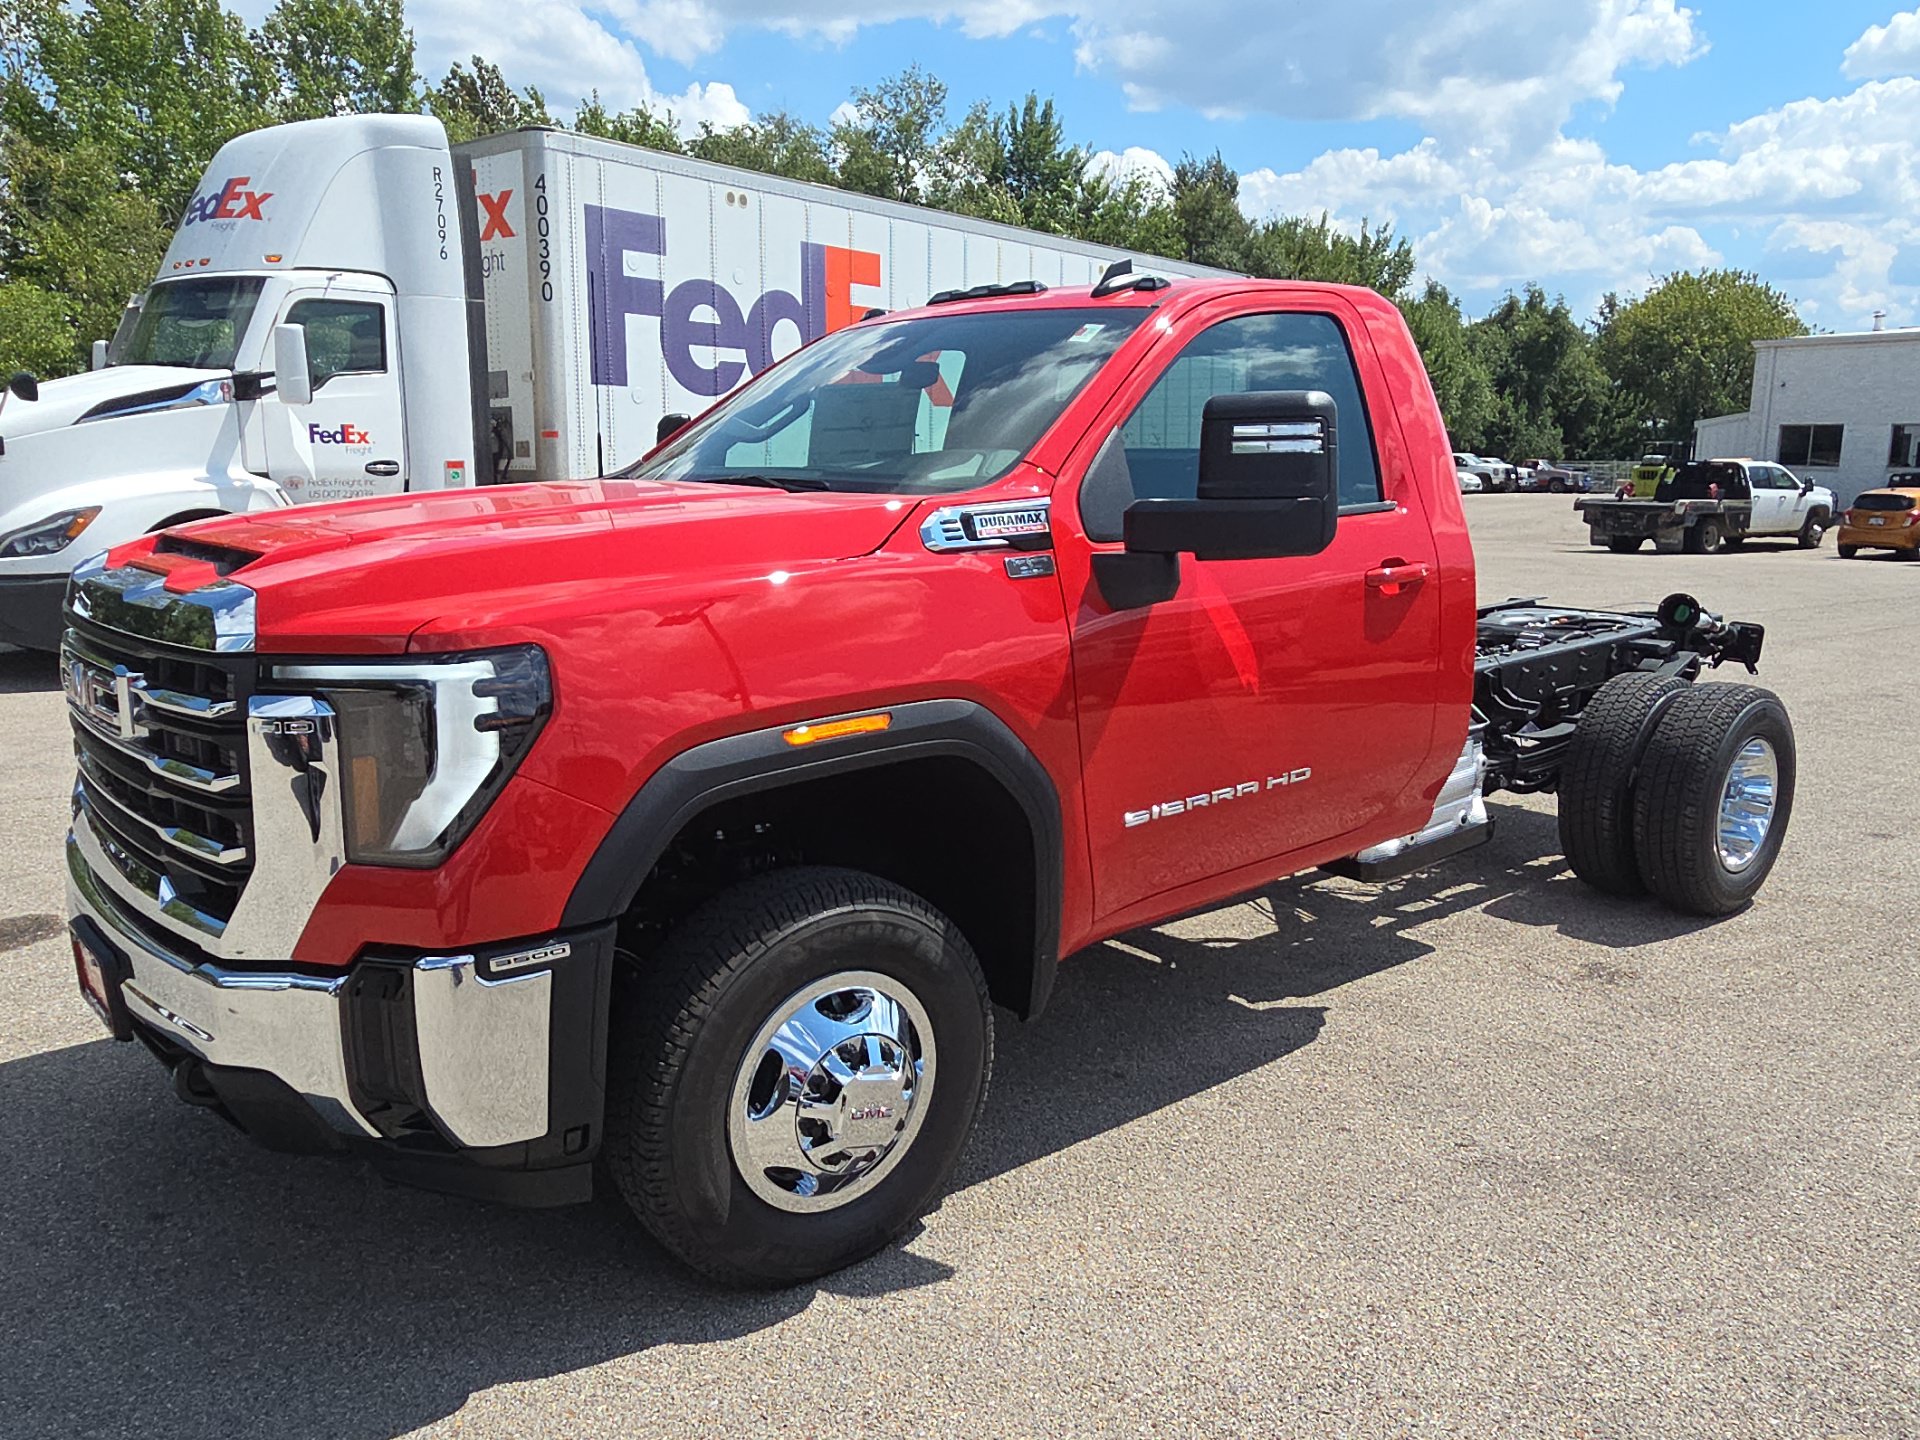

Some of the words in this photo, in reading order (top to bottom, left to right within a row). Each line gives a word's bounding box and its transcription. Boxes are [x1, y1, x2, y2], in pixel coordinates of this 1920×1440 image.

[185, 176, 274, 227] edEx
[433, 167, 448, 260] R27096
[534, 173, 553, 302] 400390
[308, 423, 370, 444] FedEx
[979, 512, 1043, 528] DURAMAX
[1124, 781, 1259, 828] SIERRA
[1266, 767, 1312, 790] HD
[489, 942, 571, 972] 3500
[851, 1107, 895, 1120] GMC
